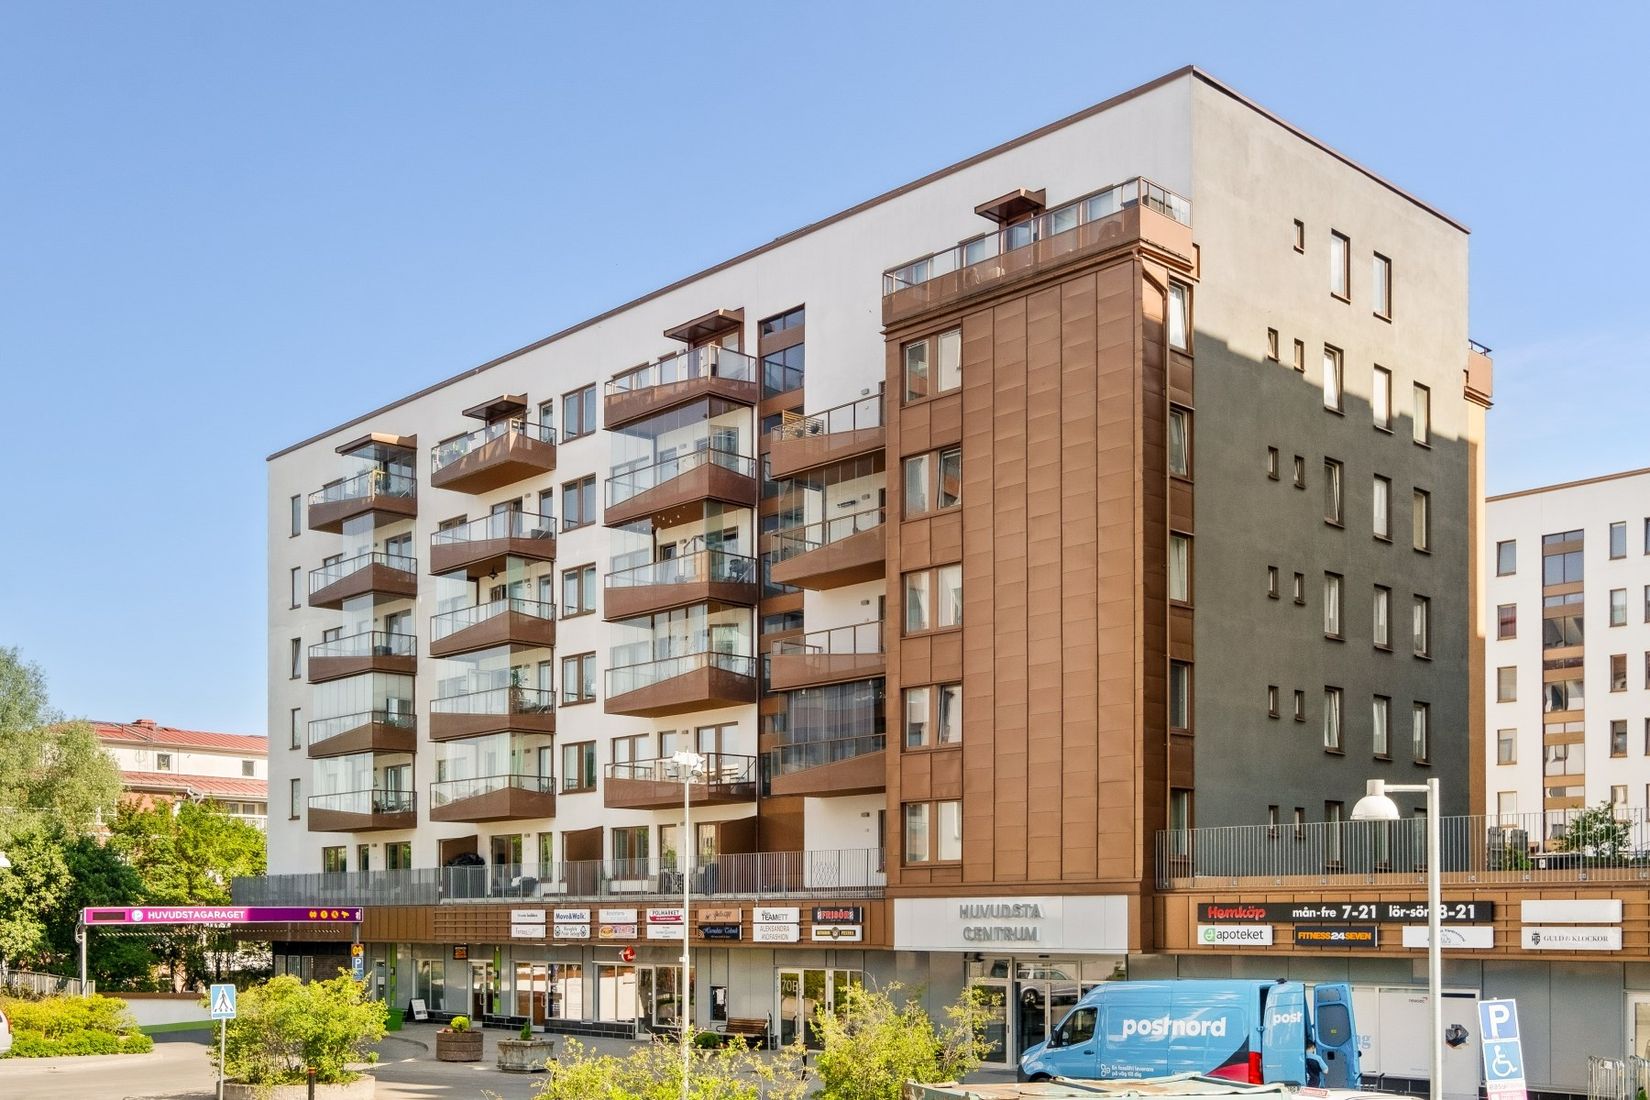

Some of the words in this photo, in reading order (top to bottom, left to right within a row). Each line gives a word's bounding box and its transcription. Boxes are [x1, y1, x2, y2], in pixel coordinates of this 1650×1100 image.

[148, 910, 246, 919] HUVUDSTAGARAGET
[822, 909, 849, 919] FRISÖR
[959, 904, 1041, 918] HUVUDSTA
[1208, 906, 1265, 920] Hemköp
[1292, 906, 1336, 918] mån-fre
[1342, 905, 1376, 919] 7-21
[963, 927, 1037, 941] CENTRUM
[1216, 928, 1263, 942] apoteket
[1298, 932, 1372, 941] FITNESS24SEVEN
[355, 958, 362, 967] P
[1273, 1011, 1302, 1025] post
[1488, 1004, 1510, 1038] P
[1122, 1015, 1226, 1039] postnord
